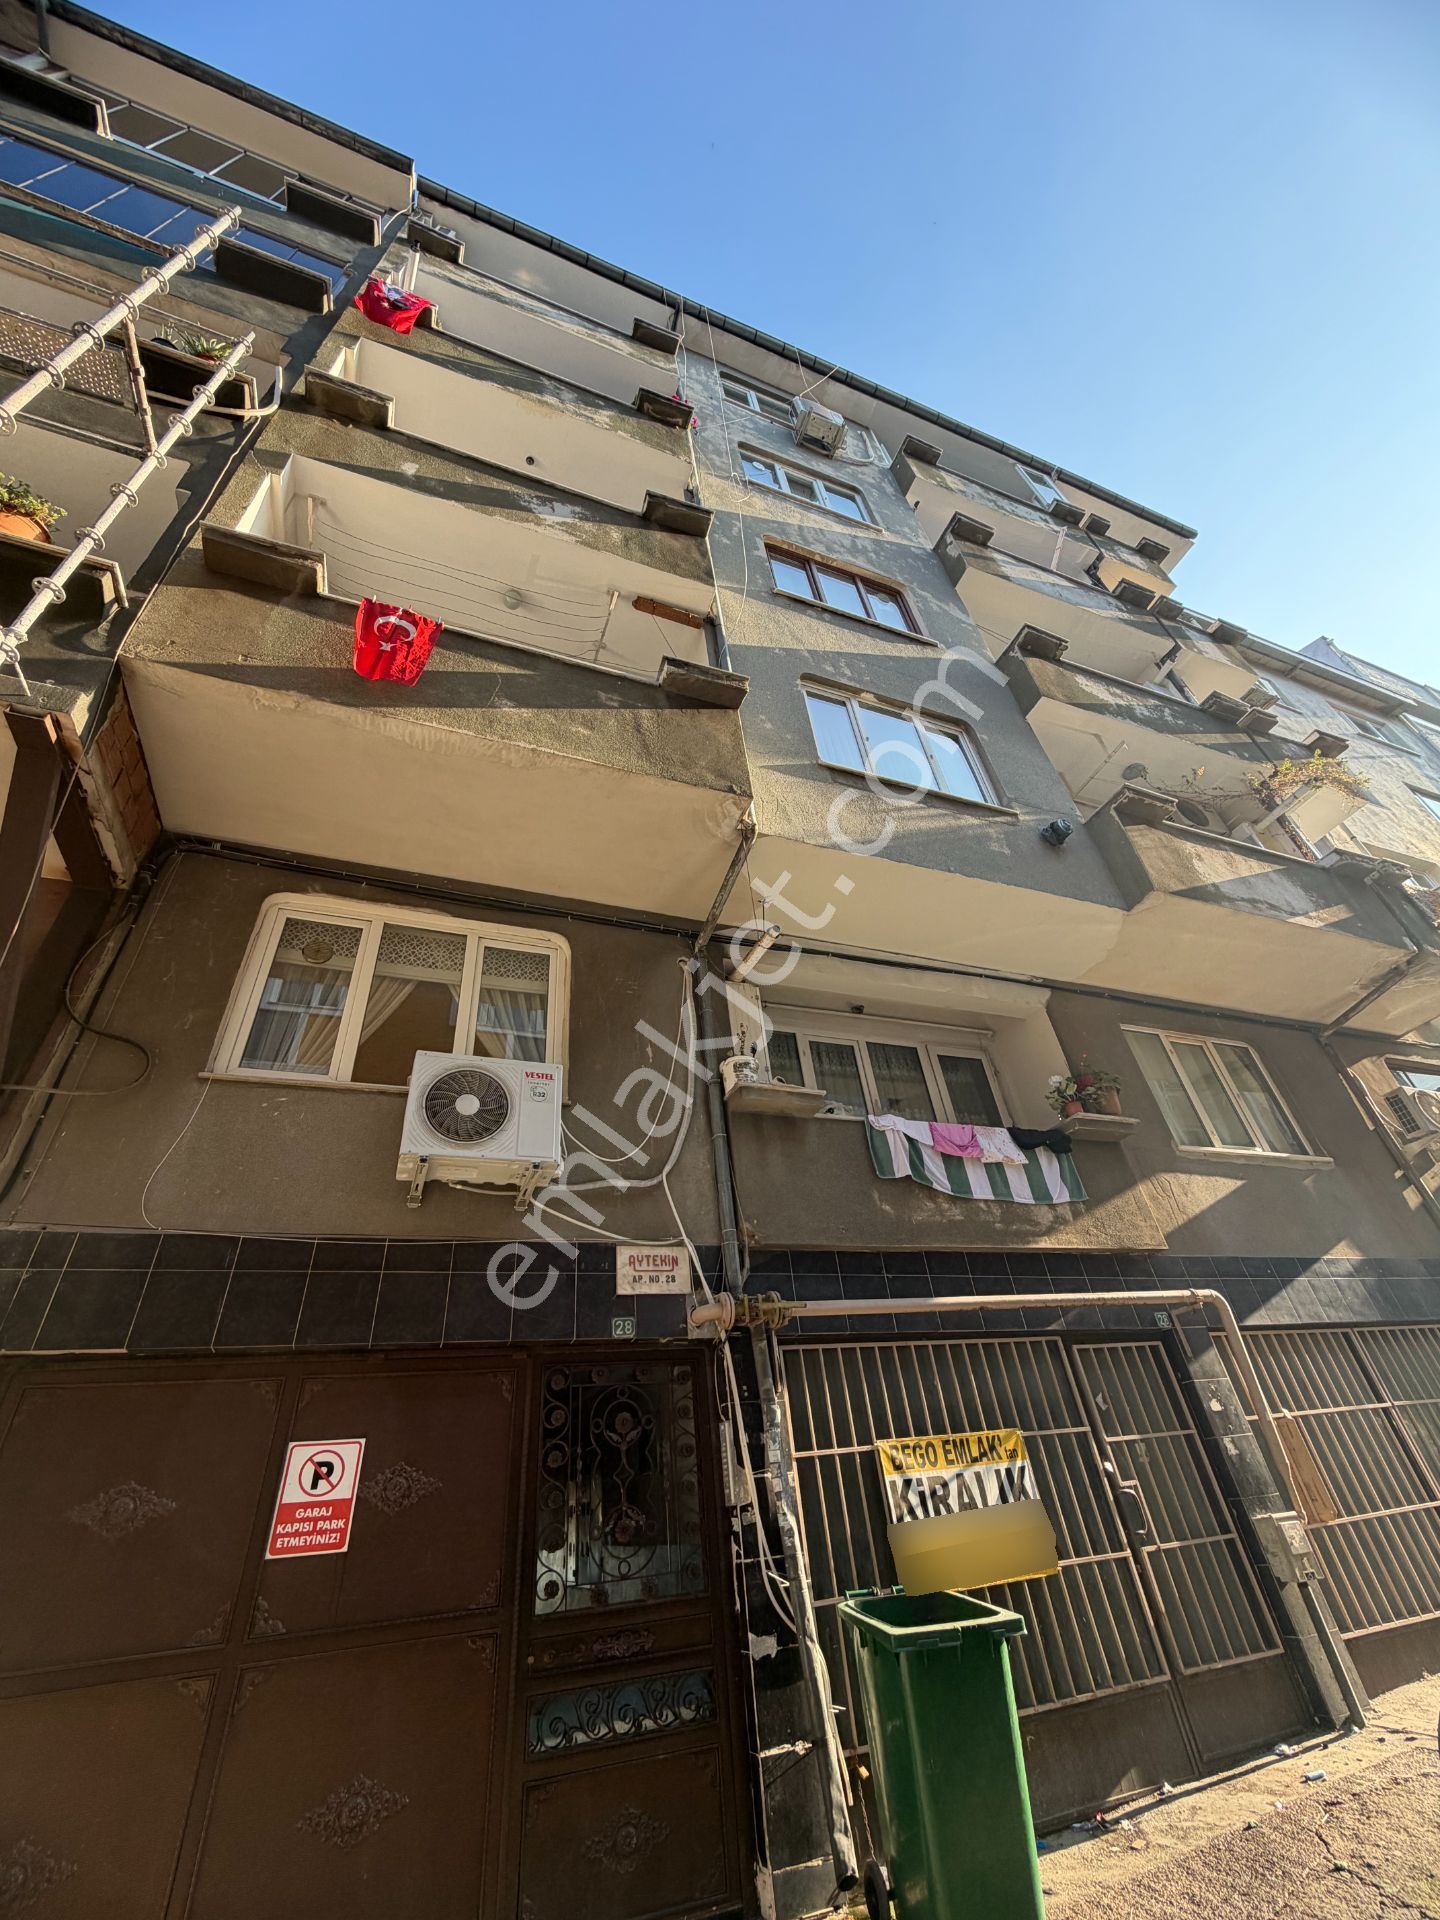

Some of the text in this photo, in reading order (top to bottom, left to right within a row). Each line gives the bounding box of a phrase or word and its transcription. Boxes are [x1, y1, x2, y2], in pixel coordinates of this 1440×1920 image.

[525, 1071, 555, 1081] VESTEL
[615, 1320, 633, 1335] 28
[889, 1440, 939, 1472] BEGO
[295, 1506, 333, 1519] GARAJ
[276, 1518, 347, 1534] KAPISI PARK
[276, 1532, 341, 1549] ETMEYİNİZ!
